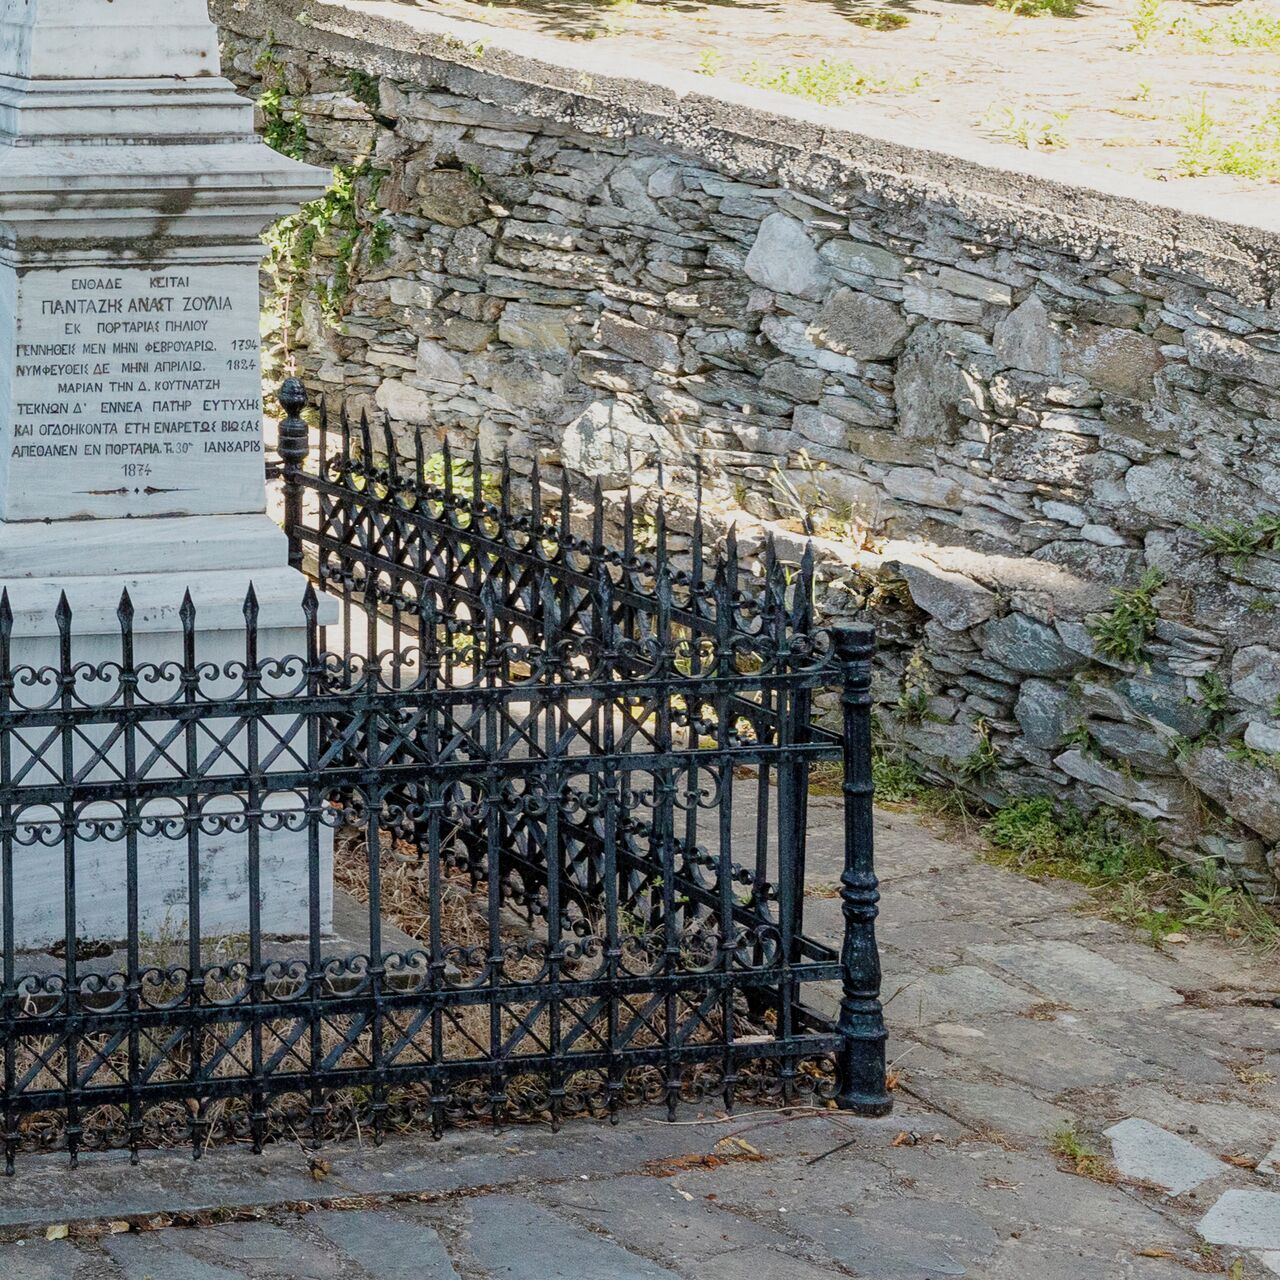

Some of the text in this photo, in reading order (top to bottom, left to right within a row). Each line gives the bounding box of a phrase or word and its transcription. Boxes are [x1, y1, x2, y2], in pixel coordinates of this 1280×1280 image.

[71, 276, 189, 290] ΕΝΘΑΔΕ ΚΕΙΤΑΙ
[42, 298, 123, 315] ΠΑΝΤΑΖΗΣ
[182, 295, 233, 312] ΖΟΥΛΙΑ
[64, 320, 208, 335] ΕΚ ΠΟΡΤΑΡΙΑΣ ΠΗΛΙΟΥ
[82, 343, 106, 355] ΜΕΝ
[112, 342, 139, 354] ΜΗΝΙ
[93, 363, 110, 375] ΔΕ
[121, 361, 149, 373] ΜΗΝΙ
[226, 358, 256, 371] 1824
[58, 379, 221, 393] ΜΑΡΙΑΝ ΤΗΝ Δ. ΚΟΥΤΝΑΤΖΗ
[17, 402, 69, 415] ΤΕΚΝΩΝ
[100, 401, 142, 414] ΕΝΝΕΑ
[152, 400, 192, 412] ΠΑΤΗΡ
[203, 399, 259, 412] ΕΥΤΥΧΗΣ
[14, 423, 33, 437] ΚΑΙ
[39, 422, 118, 436] ΟΓΔΟΗΚΟΝΤΑ
[124, 422, 150, 434] ΕΤΗ
[84, 444, 101, 456] ΕΝ
[121, 463, 152, 477] 1874
